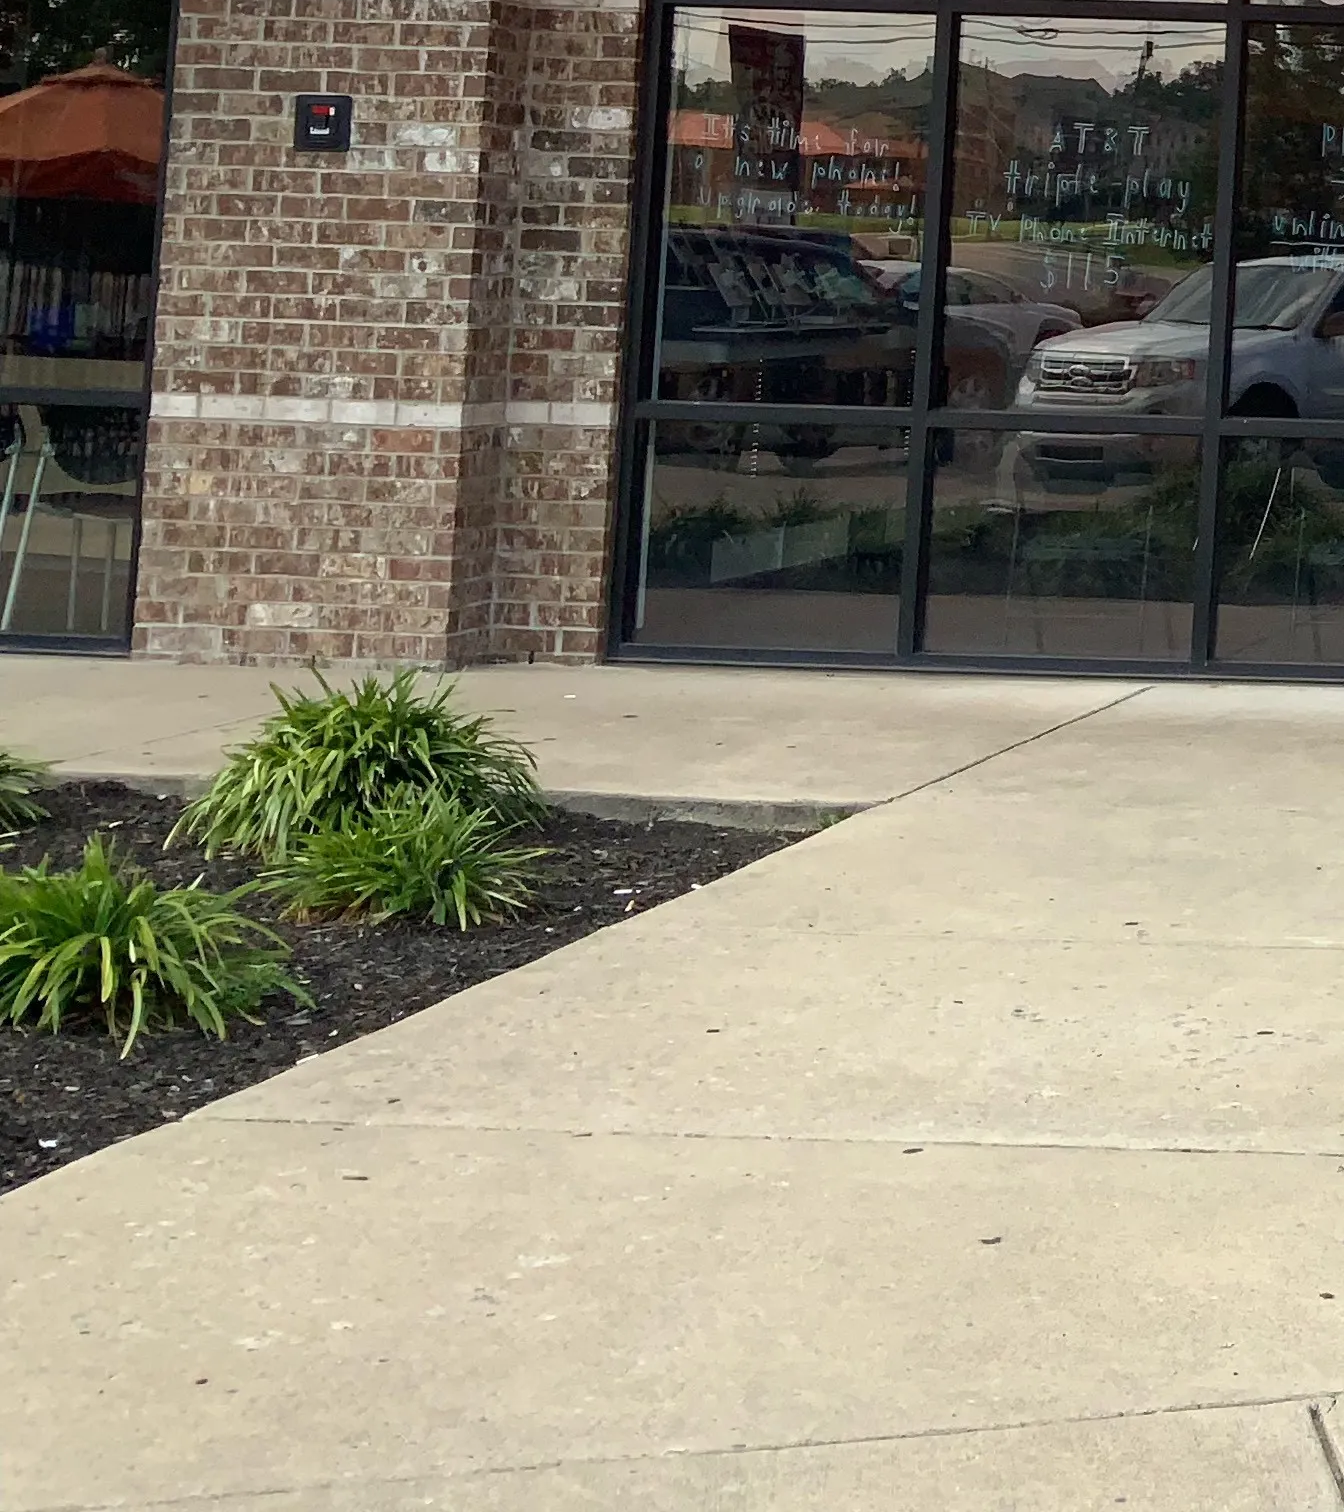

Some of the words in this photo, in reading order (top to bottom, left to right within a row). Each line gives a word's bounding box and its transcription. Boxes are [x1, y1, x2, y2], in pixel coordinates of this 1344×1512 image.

[767, 117, 821, 149] time
[846, 128, 889, 156] for
[735, 156, 788, 180] new
[812, 155, 900, 191] phone!
[838, 190, 917, 234] today!
[966, 210, 1002, 236] TV
